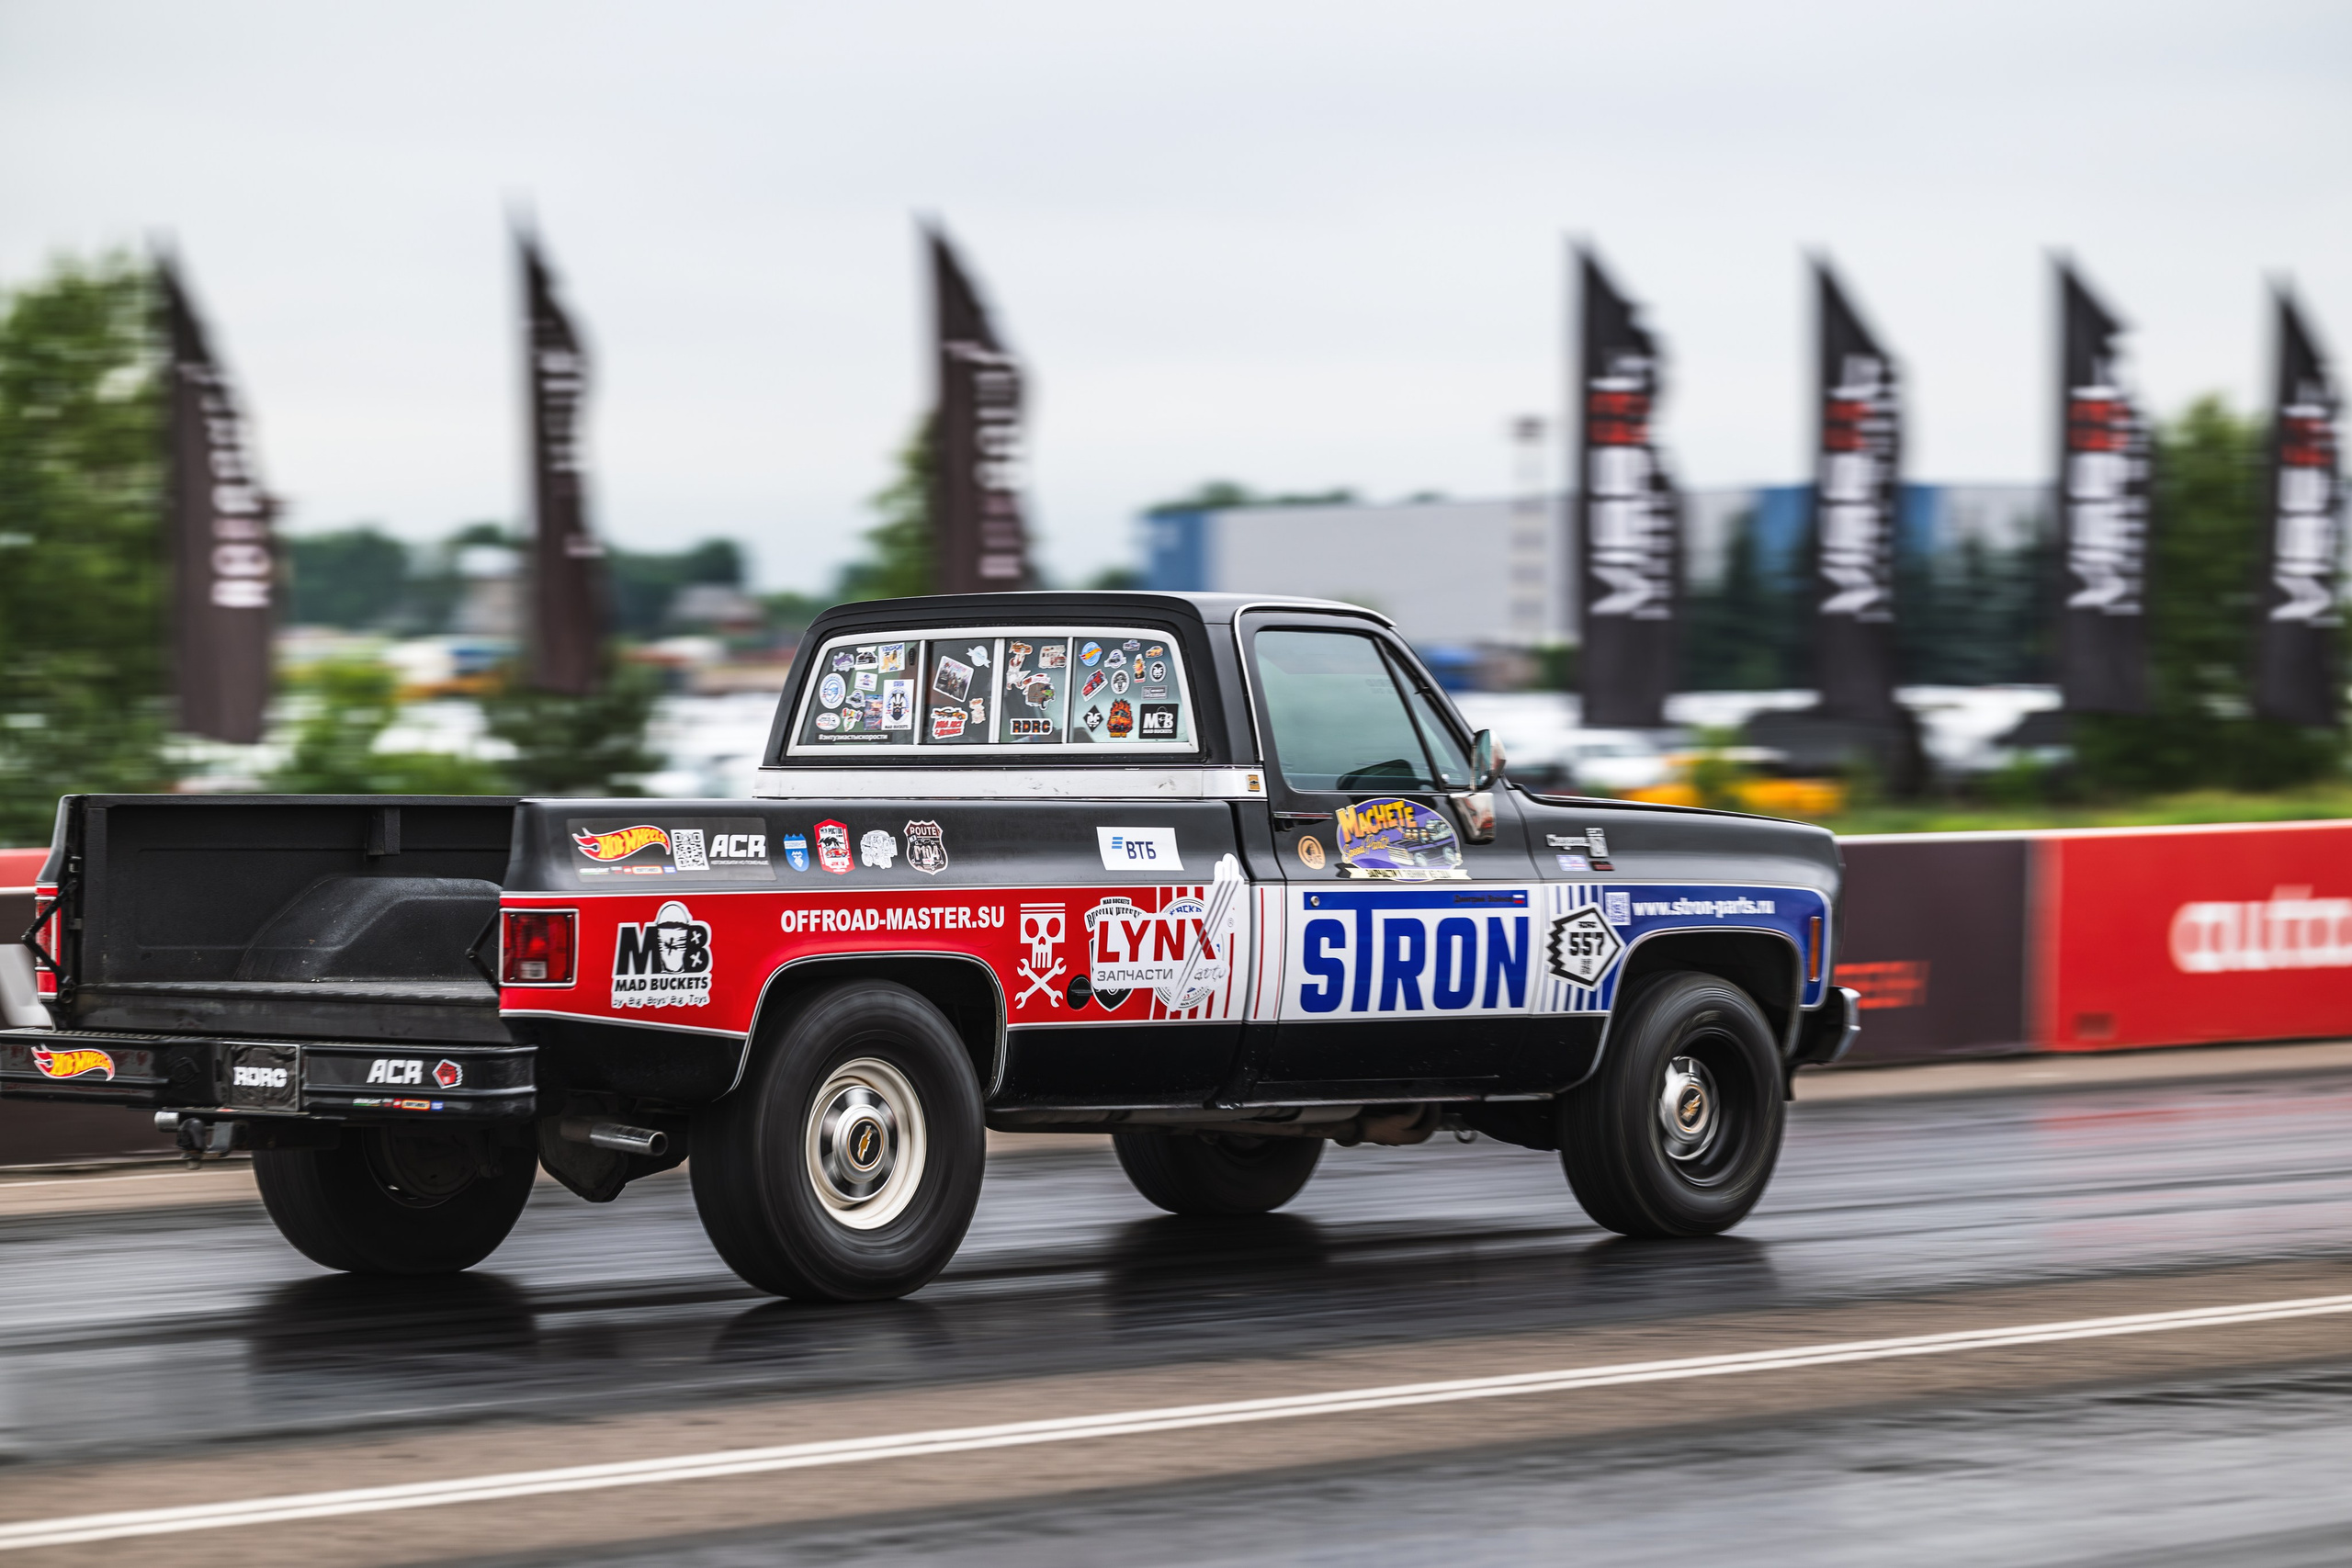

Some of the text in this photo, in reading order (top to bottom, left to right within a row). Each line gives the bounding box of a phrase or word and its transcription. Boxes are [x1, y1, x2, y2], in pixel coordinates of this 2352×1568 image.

[910, 826, 937, 836] ROUTE
[1338, 799, 1418, 843] MACHETE
[600, 827, 666, 859] HOT WHEELS
[709, 834, 767, 858] ACR
[1125, 840, 1157, 860] ВТБ
[781, 906, 1005, 933] OFFROAD-MASTER.SU
[1097, 919, 1217, 964] LYNX
[1569, 931, 1605, 956] 557
[615, 976, 708, 992] MAD BUCKETS
[1097, 969, 1173, 982] ЗАПЧАСТИ
[367, 1059, 424, 1085] ACR
